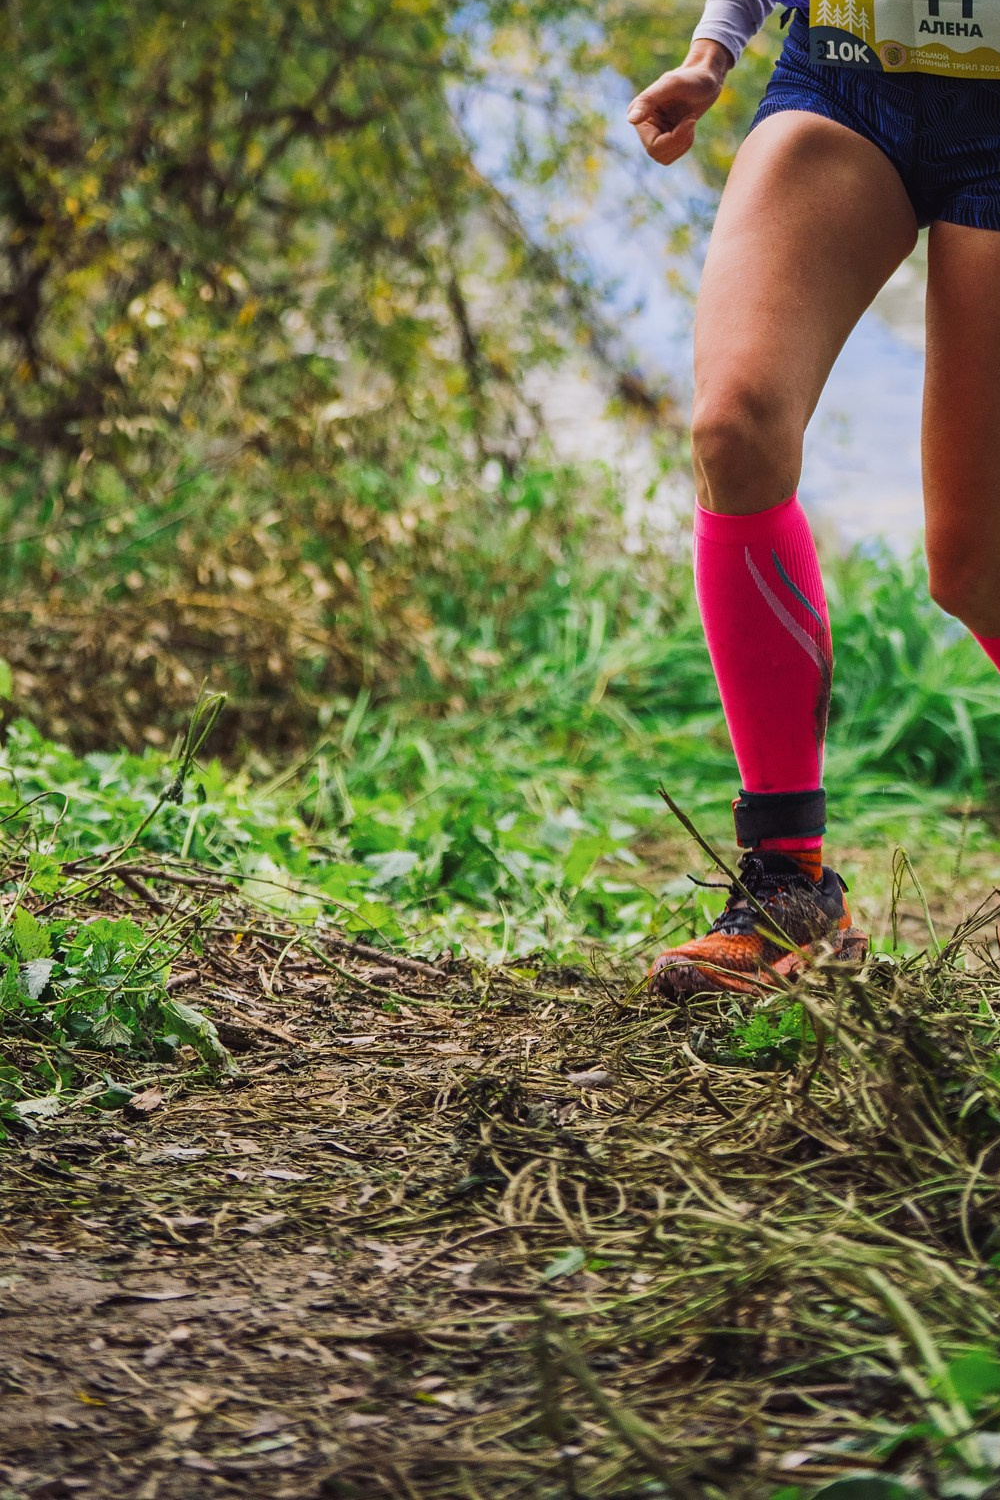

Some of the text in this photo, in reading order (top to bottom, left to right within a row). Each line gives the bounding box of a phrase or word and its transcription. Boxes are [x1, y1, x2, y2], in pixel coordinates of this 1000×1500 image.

[918, 19, 984, 38] АЛЕНА
[910, 49, 950, 61] ВОСЬМОЙ
[910, 58, 1000, 72] АТОМНЫЙ ТРЕЙЛ 2025
